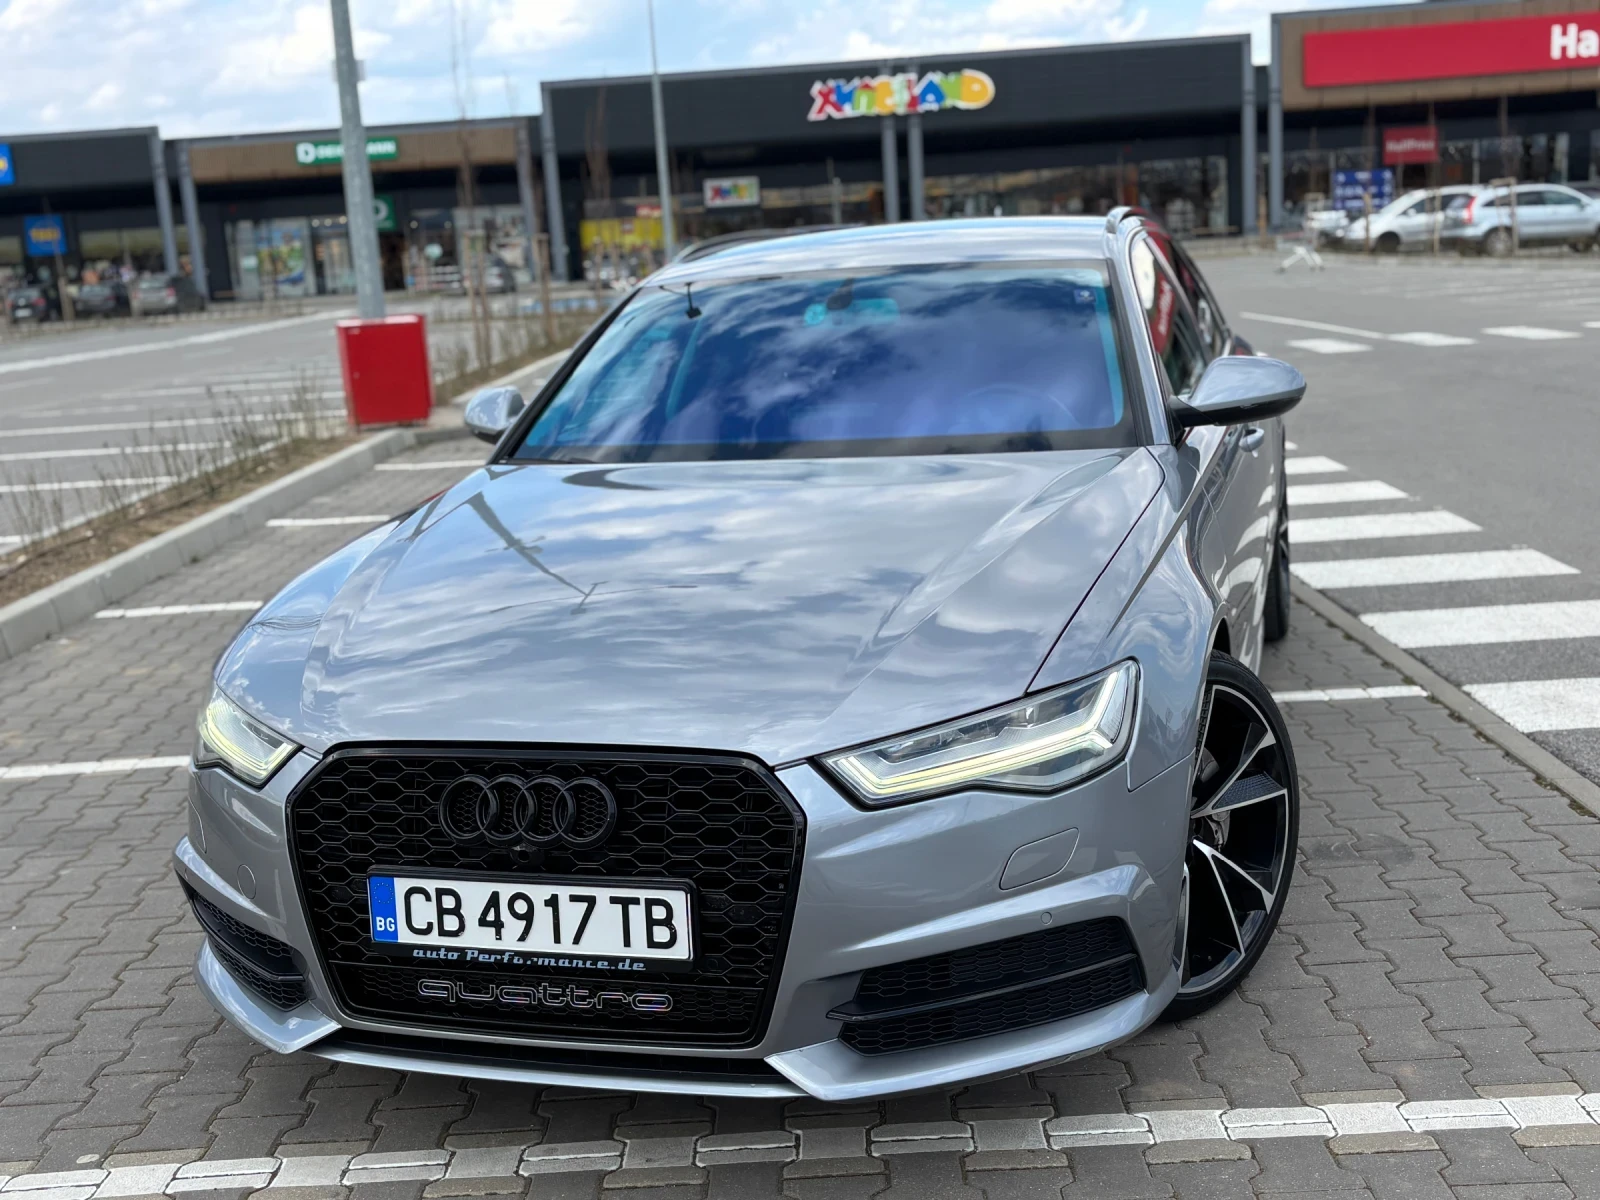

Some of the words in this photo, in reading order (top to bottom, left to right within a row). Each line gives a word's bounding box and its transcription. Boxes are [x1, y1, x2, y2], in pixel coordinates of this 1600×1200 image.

[376, 917, 395, 932] BG
[477, 890, 597, 945] 4917
[412, 947, 461, 960] auto
[417, 978, 673, 1012] quattro
